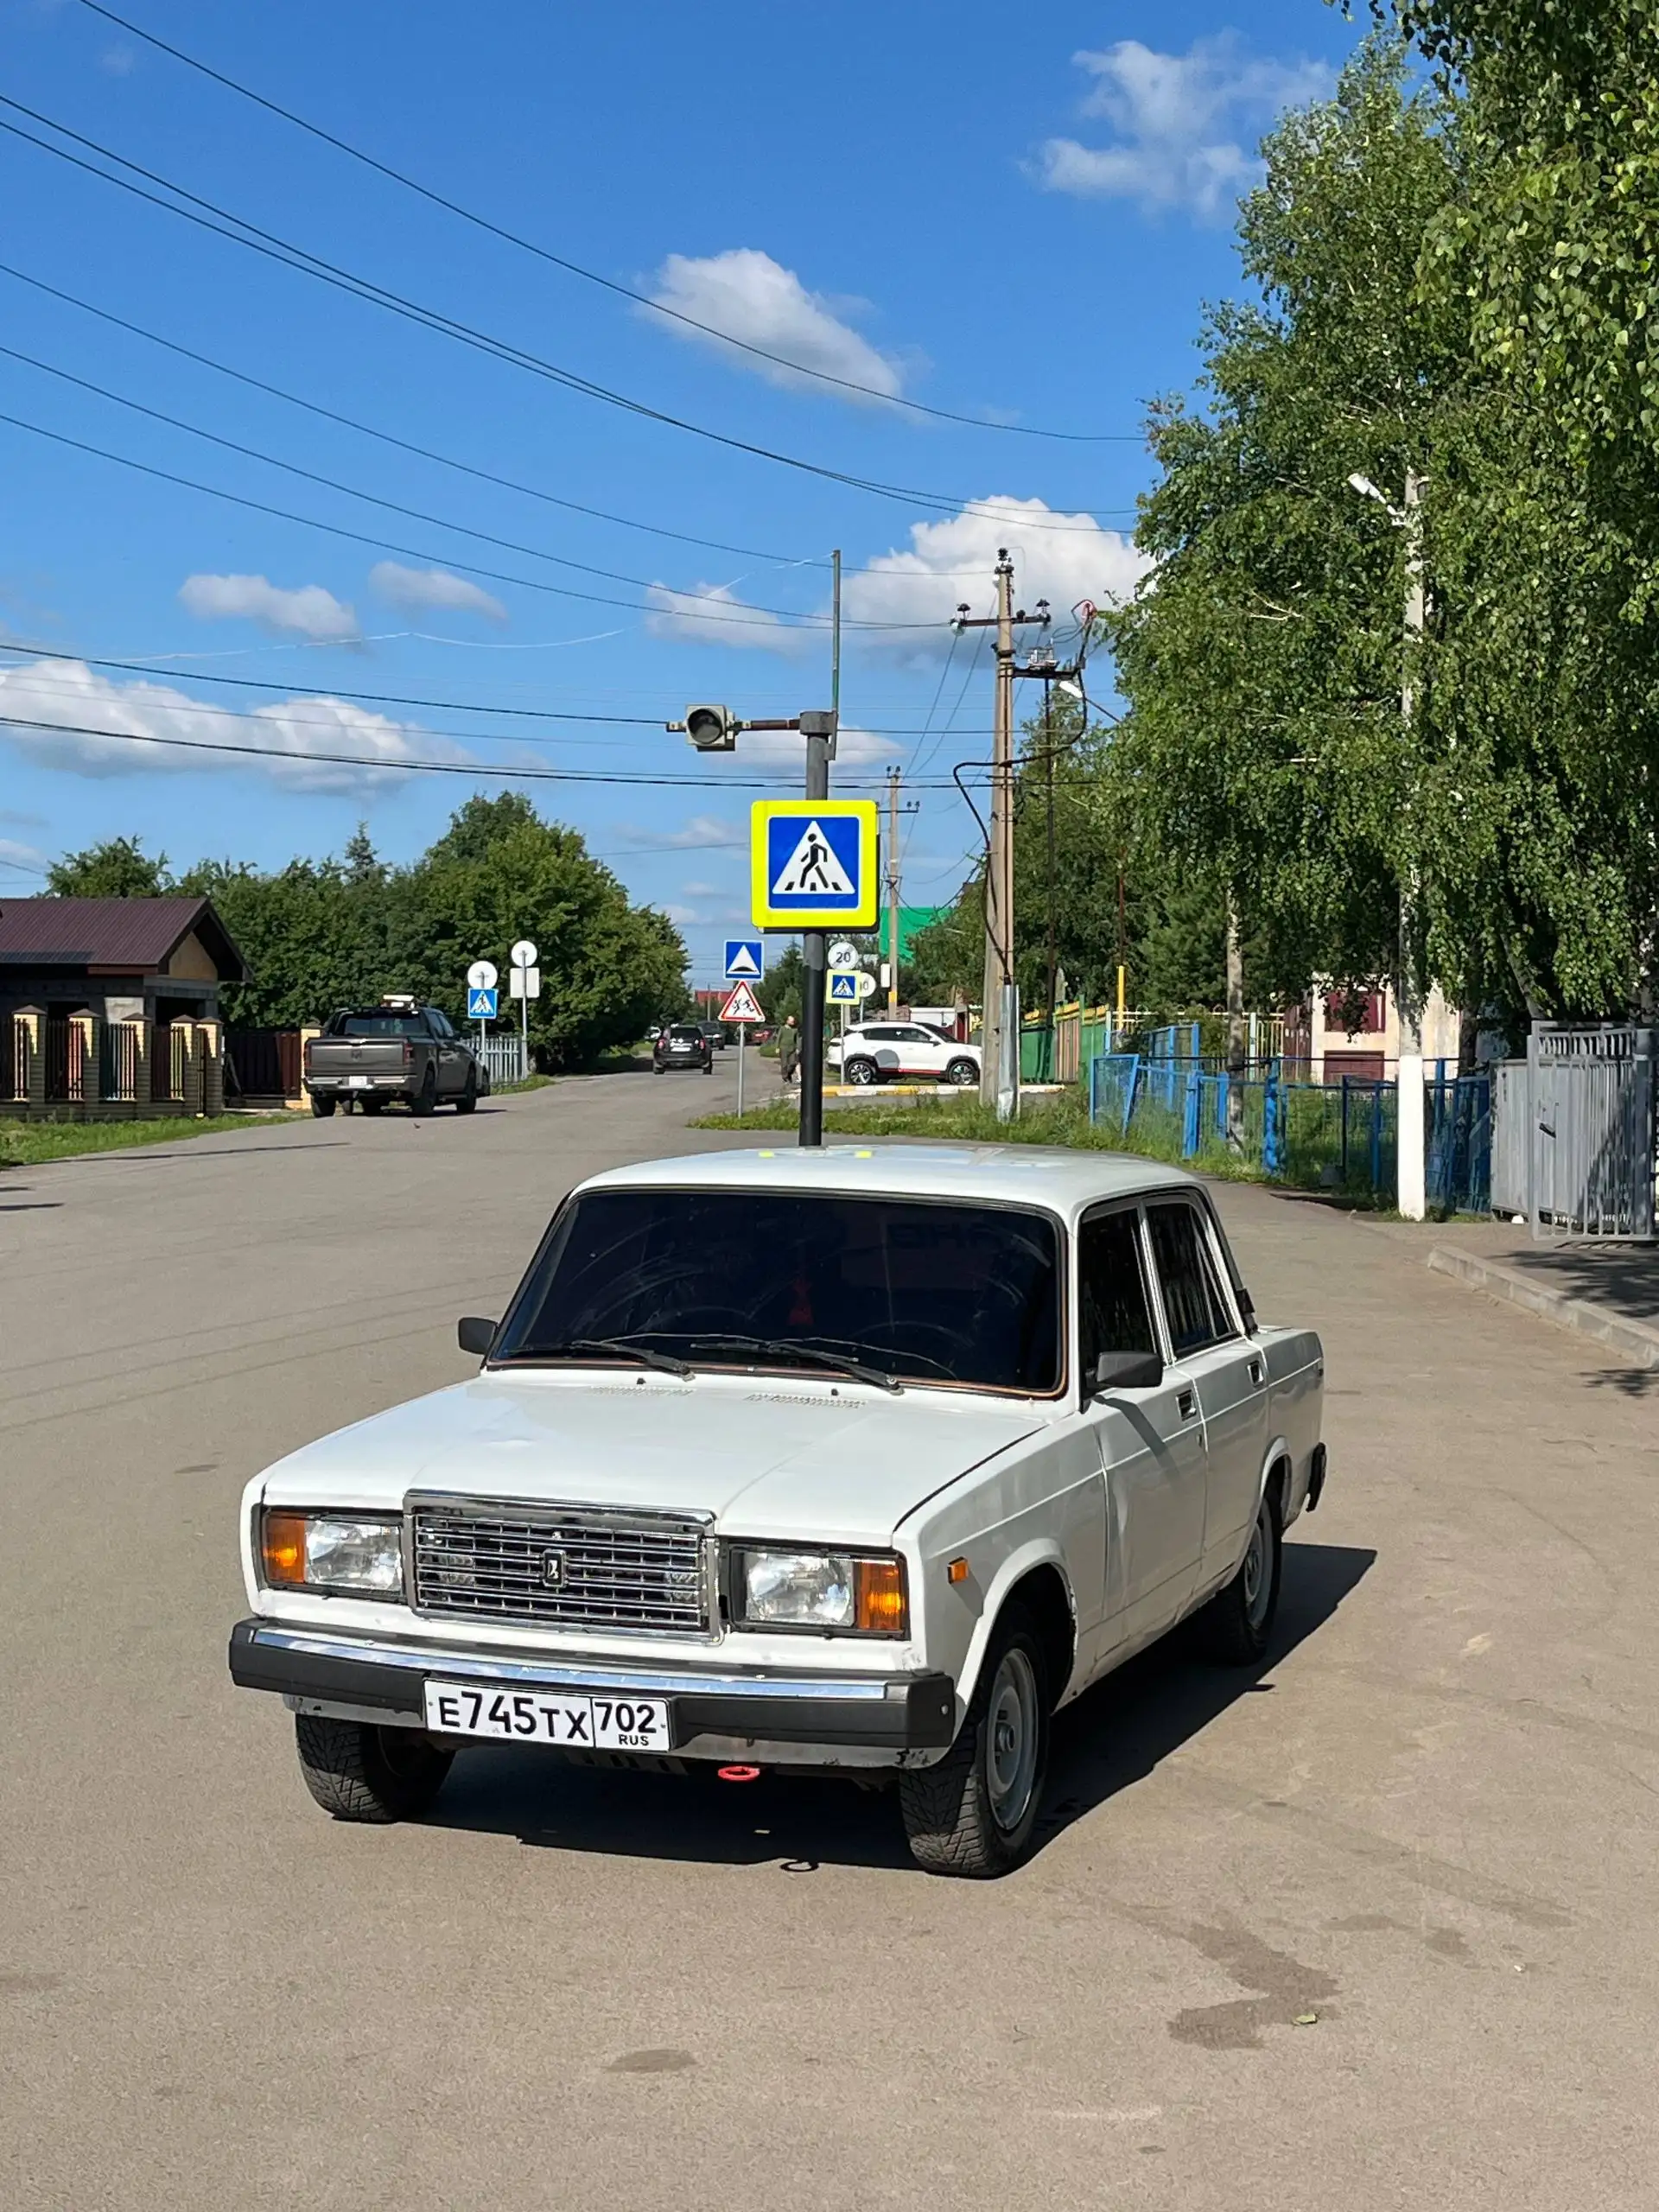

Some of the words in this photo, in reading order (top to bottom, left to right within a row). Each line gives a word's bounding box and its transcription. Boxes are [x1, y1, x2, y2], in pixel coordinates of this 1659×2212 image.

[836, 951, 851, 963] 20
[594, 1701, 658, 1734] 702
[619, 1733, 650, 1746] RUS
